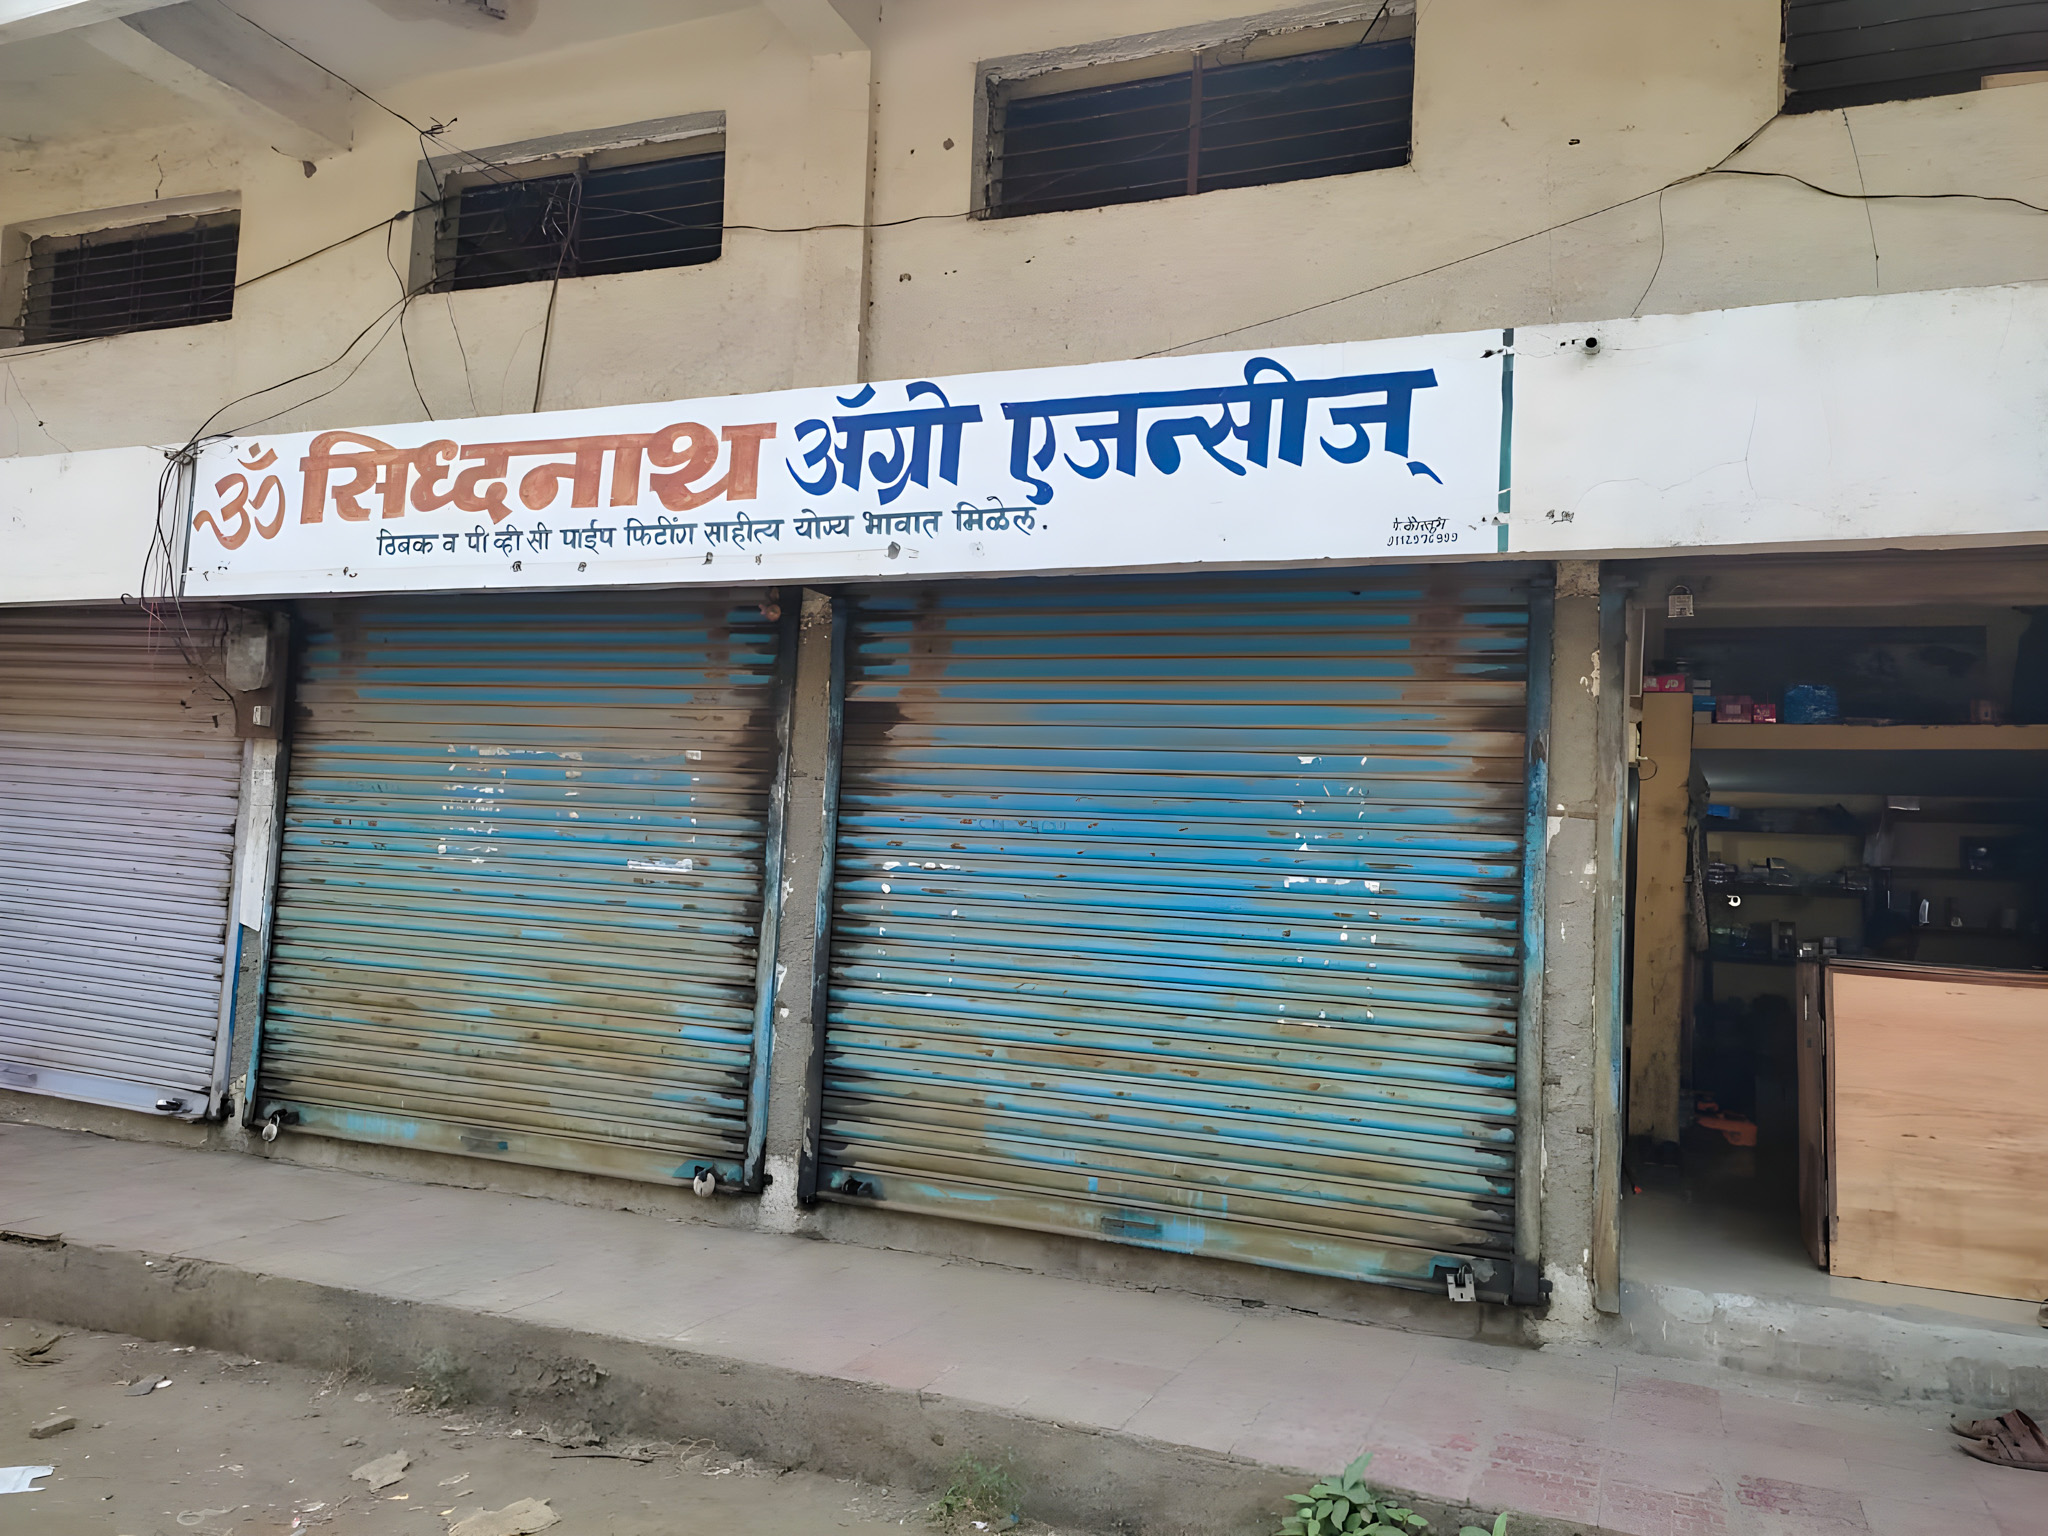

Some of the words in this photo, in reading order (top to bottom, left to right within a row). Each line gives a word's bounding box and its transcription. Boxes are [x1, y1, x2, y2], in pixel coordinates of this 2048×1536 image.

[1000, 357, 1443, 505] एजन्सीज्
[376, 528, 439, 555] ठिबक
[443, 533, 459, 553] व
[465, 524, 489, 553] पी
[494, 524, 523, 557] व्ही
[527, 522, 552, 553] सी
[559, 519, 617, 555] पाईप
[624, 516, 698, 546] फिटींग
[704, 511, 785, 550] साहीत्य
[793, 508, 855, 540] योग्य
[862, 511, 943, 539] भावात
